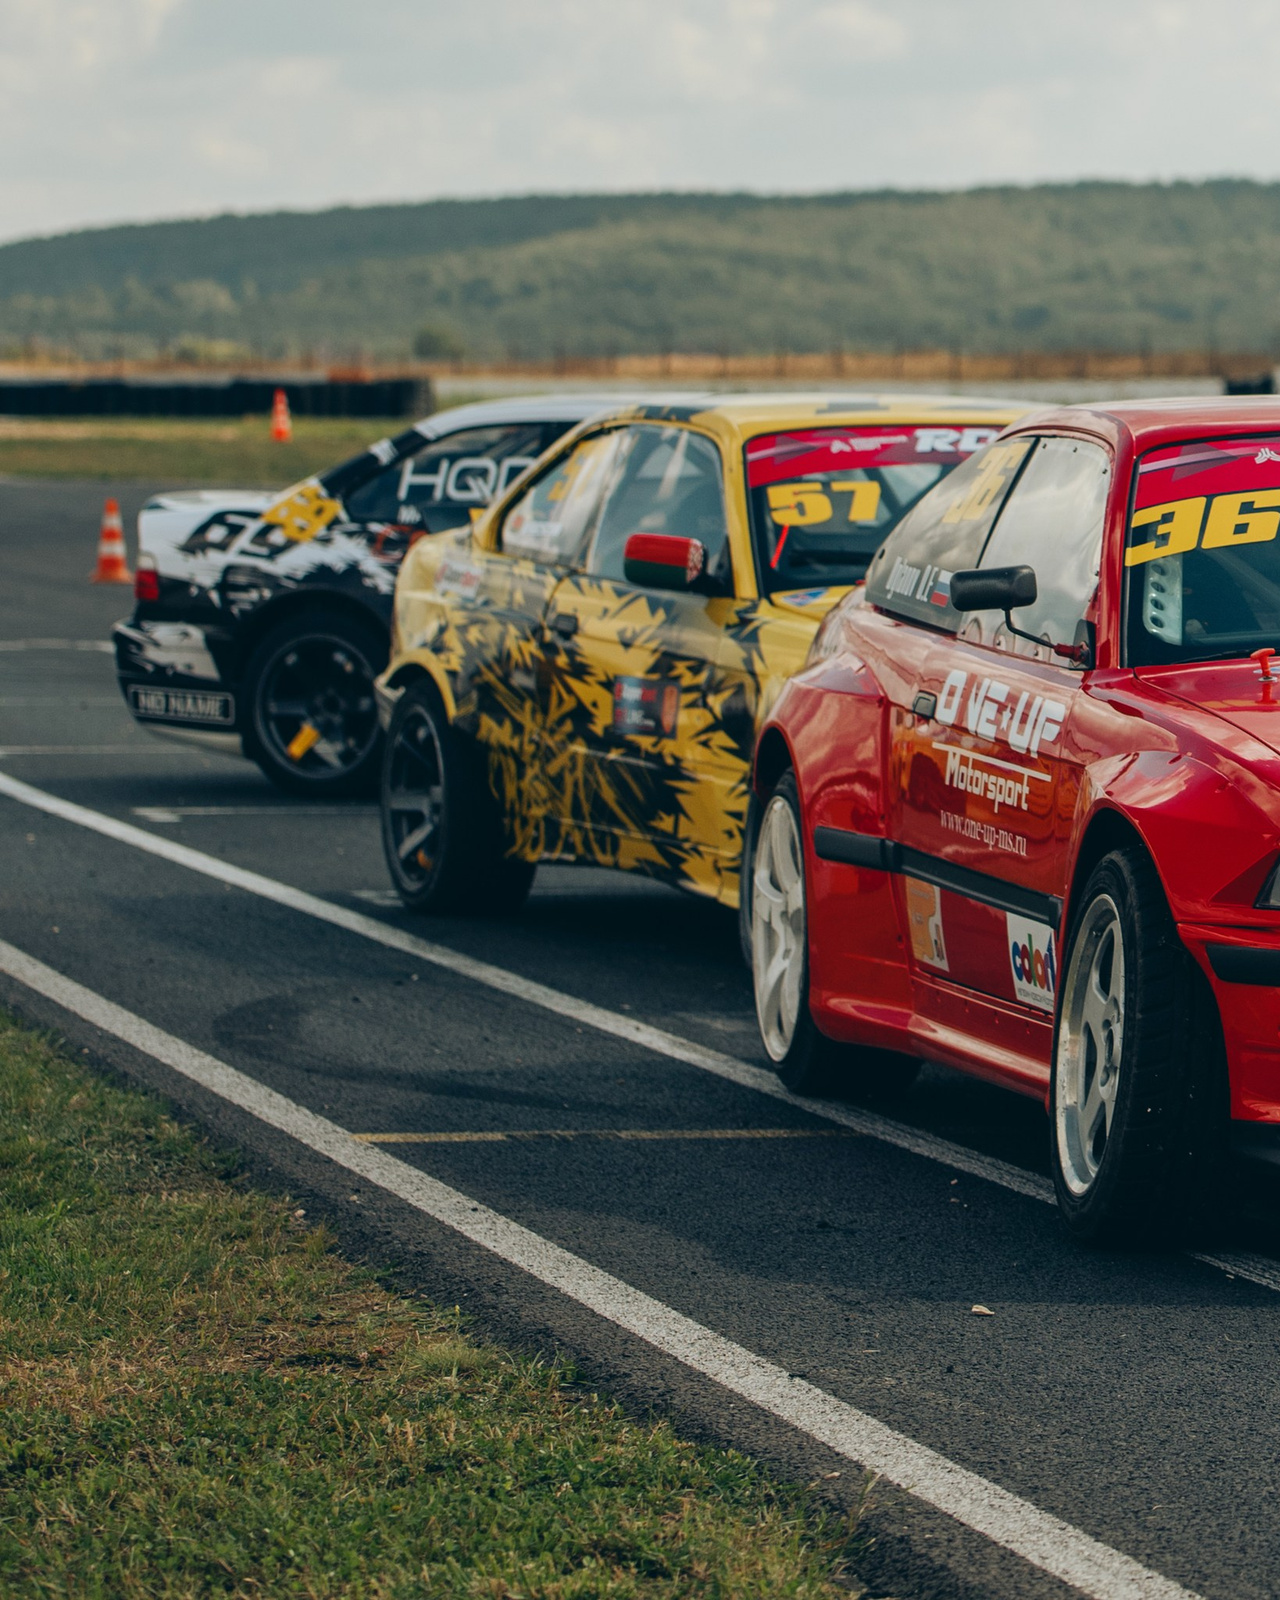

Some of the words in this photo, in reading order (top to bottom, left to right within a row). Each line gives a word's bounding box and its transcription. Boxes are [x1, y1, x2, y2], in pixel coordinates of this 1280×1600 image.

[766, 481, 881, 526] 57
[945, 750, 1030, 813] Motorsport
[940, 809, 1027, 856] www.one-up-ms.ru
